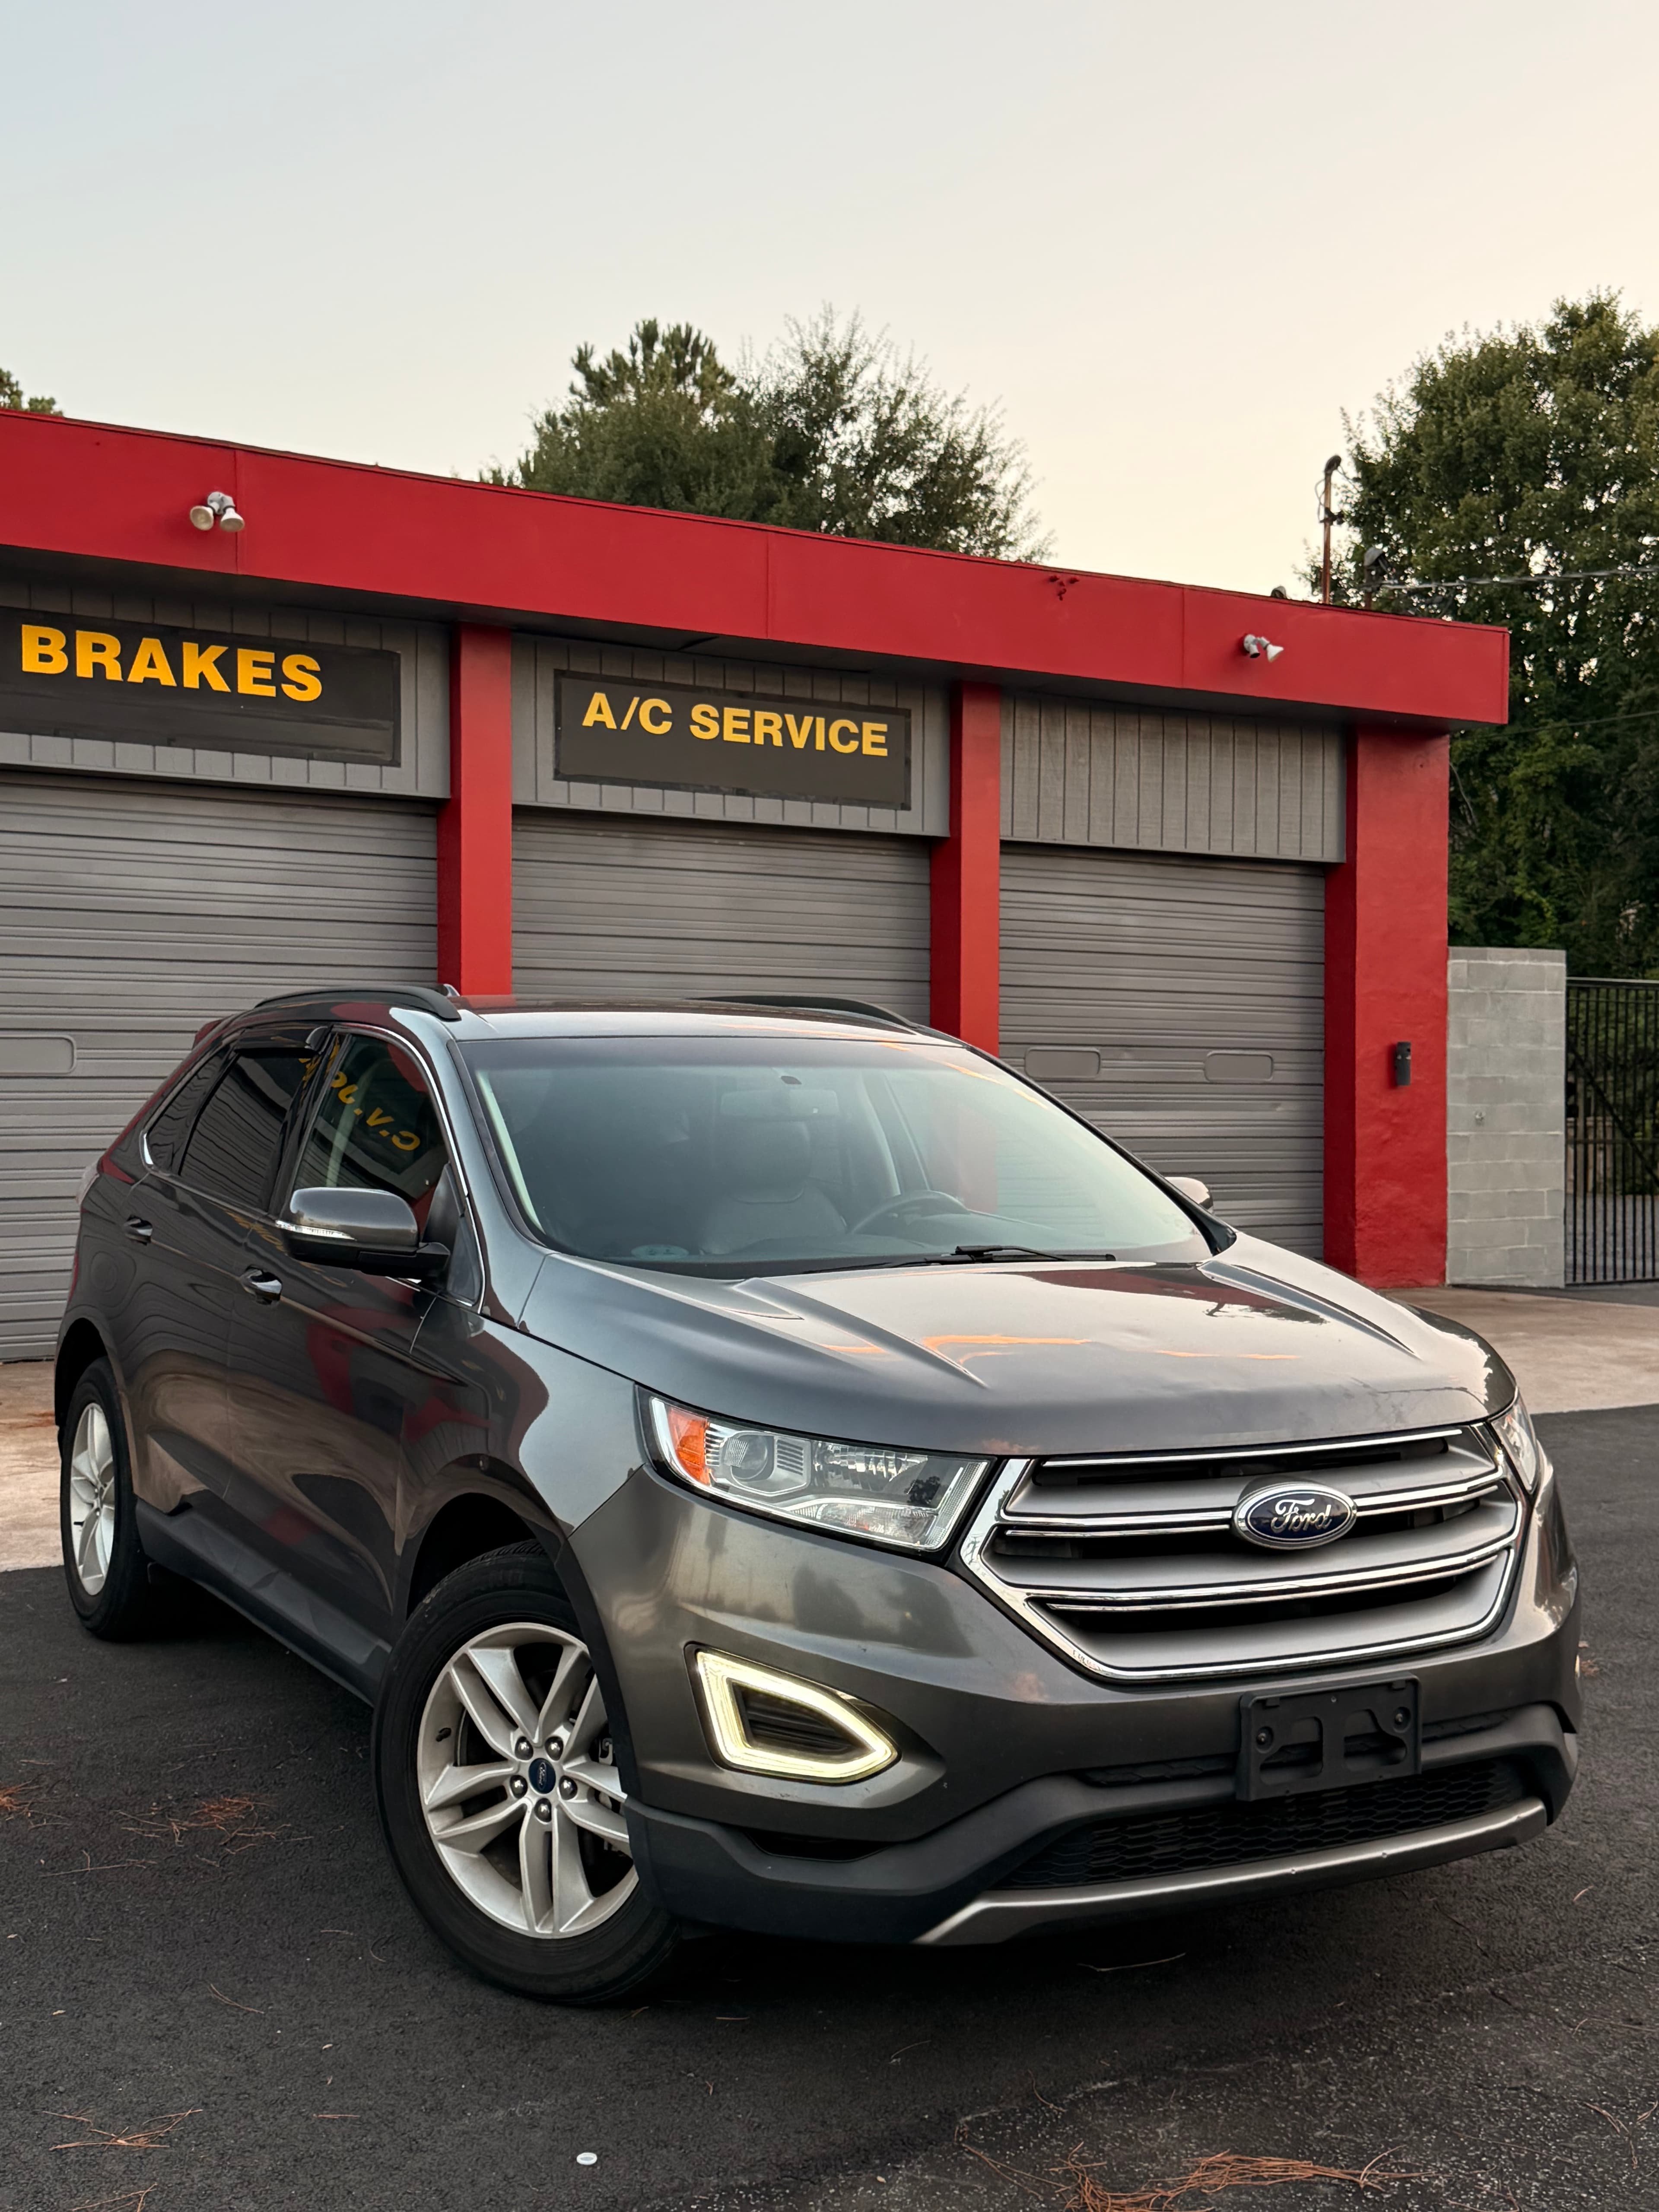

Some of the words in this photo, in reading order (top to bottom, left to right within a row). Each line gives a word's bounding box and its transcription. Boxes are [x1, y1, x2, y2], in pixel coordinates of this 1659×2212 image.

[21, 624, 322, 702] BRAKES
[582, 692, 672, 734] A/C
[689, 703, 888, 756] SERVICE
[1271, 1498, 1332, 1533] Ford
